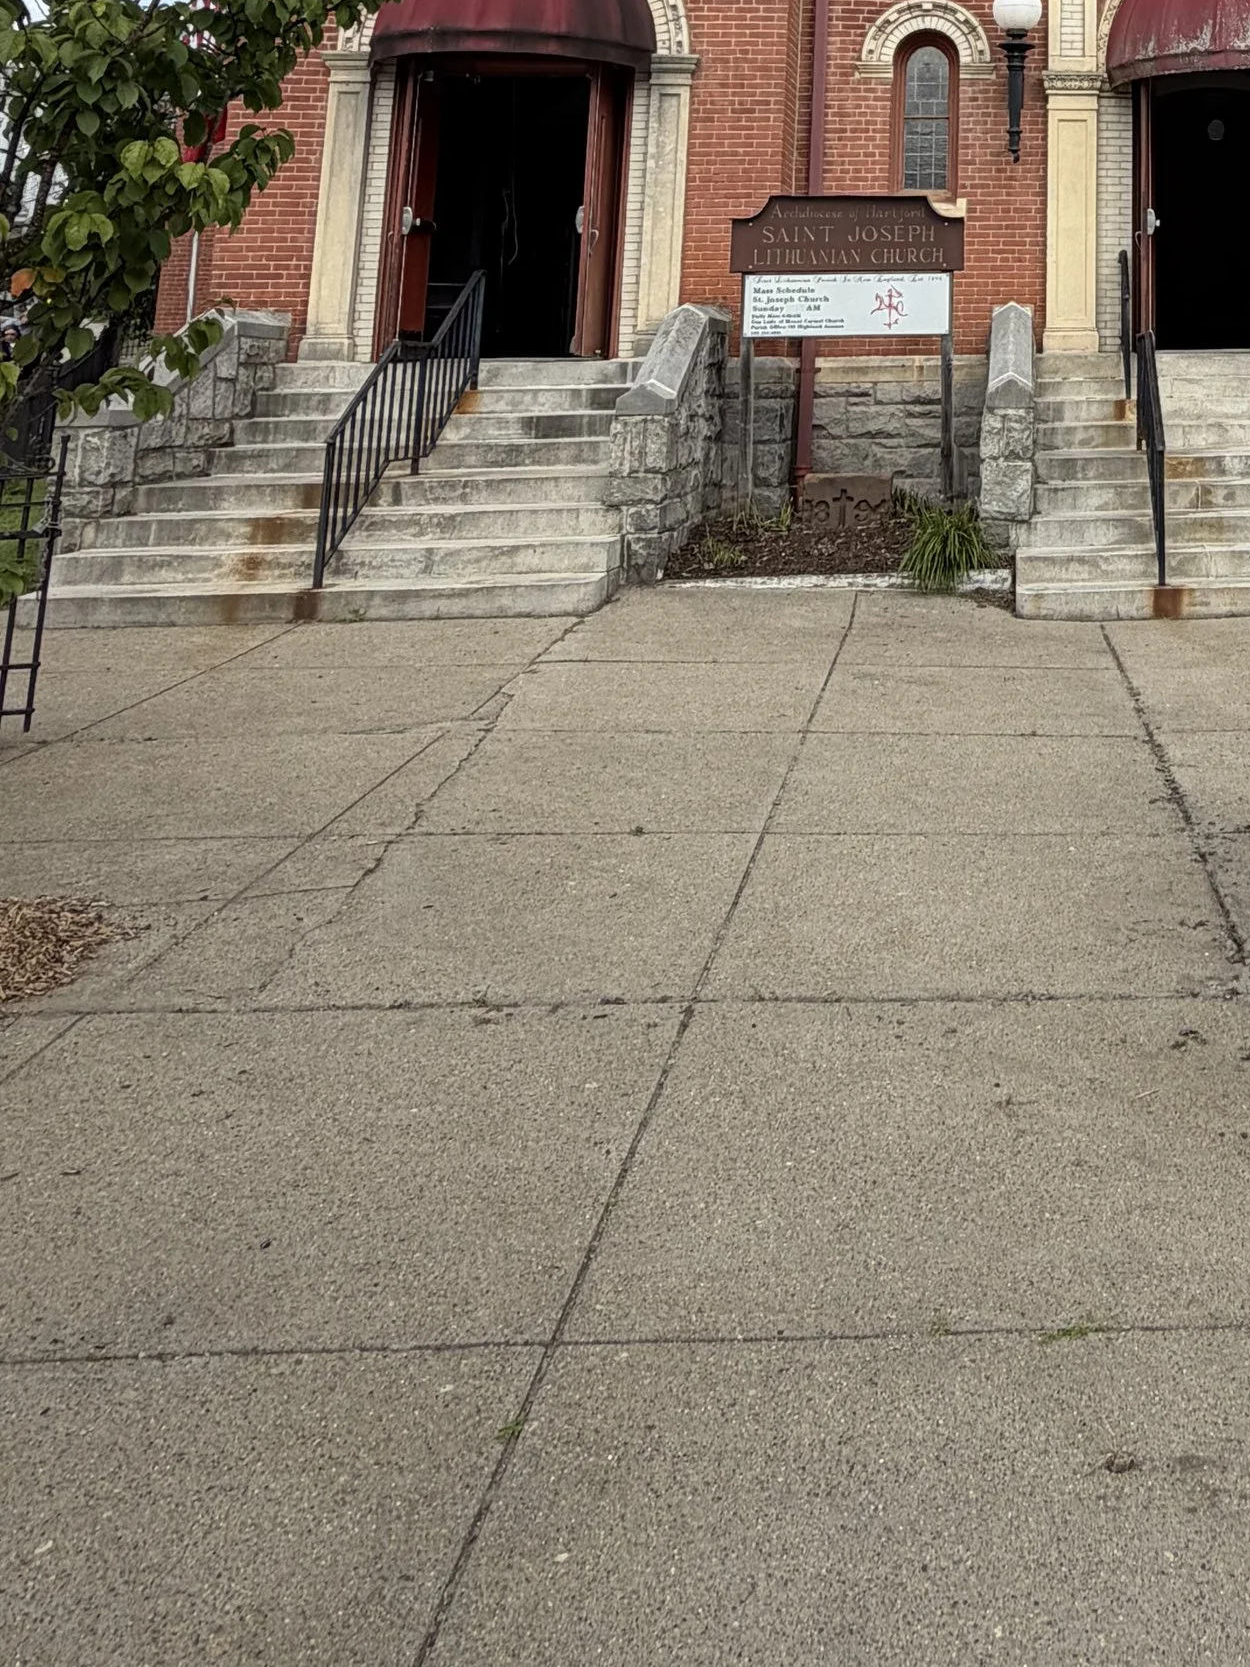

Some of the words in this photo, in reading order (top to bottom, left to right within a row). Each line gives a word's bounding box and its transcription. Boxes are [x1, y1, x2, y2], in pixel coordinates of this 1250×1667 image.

[771, 204, 844, 219] Archdiocese
[849, 207, 860, 222] of
[864, 204, 926, 222] Hartford
[762, 225, 835, 243] SAINT
[848, 225, 935, 242] JOSEPH
[753, 248, 861, 265] LITHUANIAN
[870, 248, 944, 264] CHURCH
[776, 286, 816, 294] Schedule
[765, 296, 795, 304] Joseph
[798, 295, 830, 303] Church
[752, 305, 785, 314] Sunday
